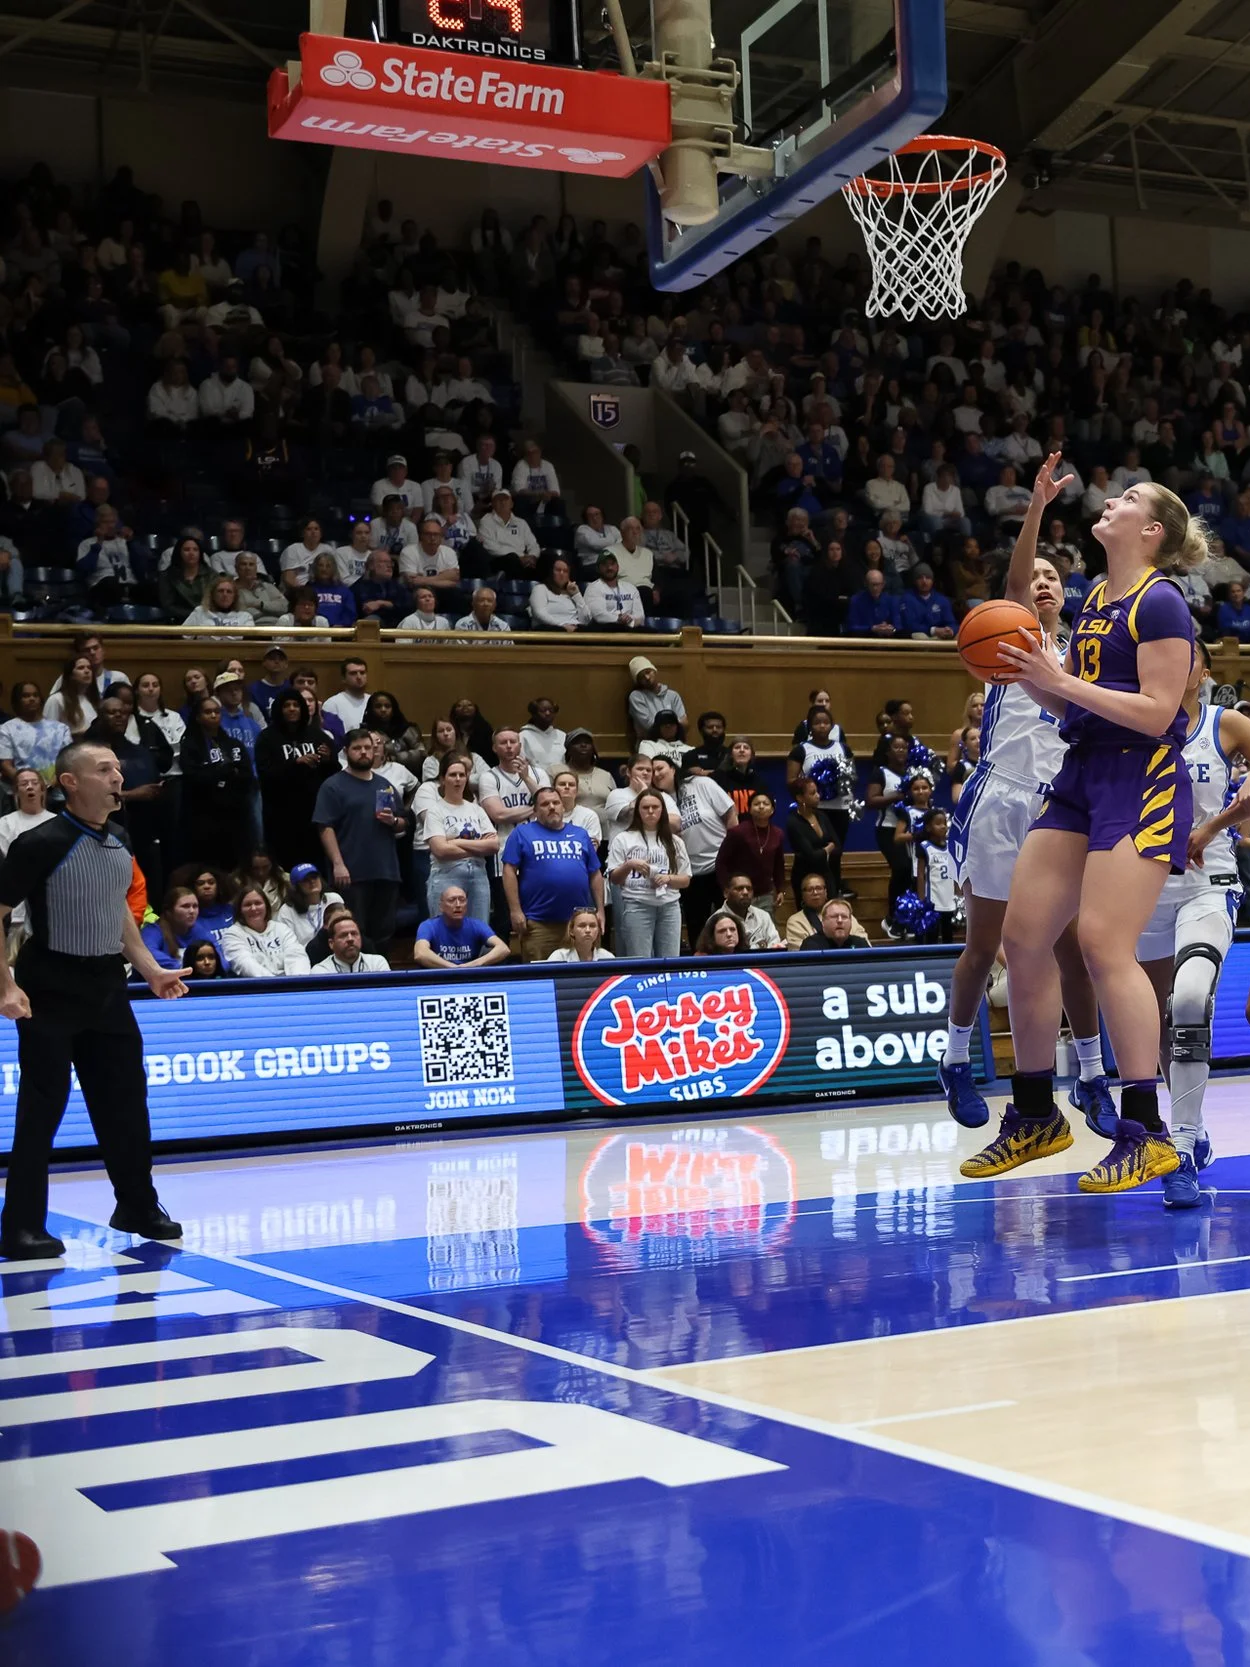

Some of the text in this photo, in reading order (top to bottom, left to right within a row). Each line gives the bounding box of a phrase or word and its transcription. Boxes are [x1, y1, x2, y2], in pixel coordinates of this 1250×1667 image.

[412, 33, 546, 60] DAKTRONICS
[597, 403, 618, 422] 15
[1064, 586, 1083, 599] UKE
[1076, 618, 1114, 636] LSU
[1077, 637, 1102, 684] 13
[532, 839, 584, 857] DUKE
[636, 972, 673, 993] SINCE
[822, 971, 946, 1020] a sub
[602, 985, 756, 1046] Jersey
[254, 1040, 392, 1080] GROUPS
[622, 1024, 762, 1091] Mike's
[815, 1025, 950, 1071] above
[424, 1086, 516, 1111] JOIN NOW
[669, 1075, 727, 1101] SUBS
